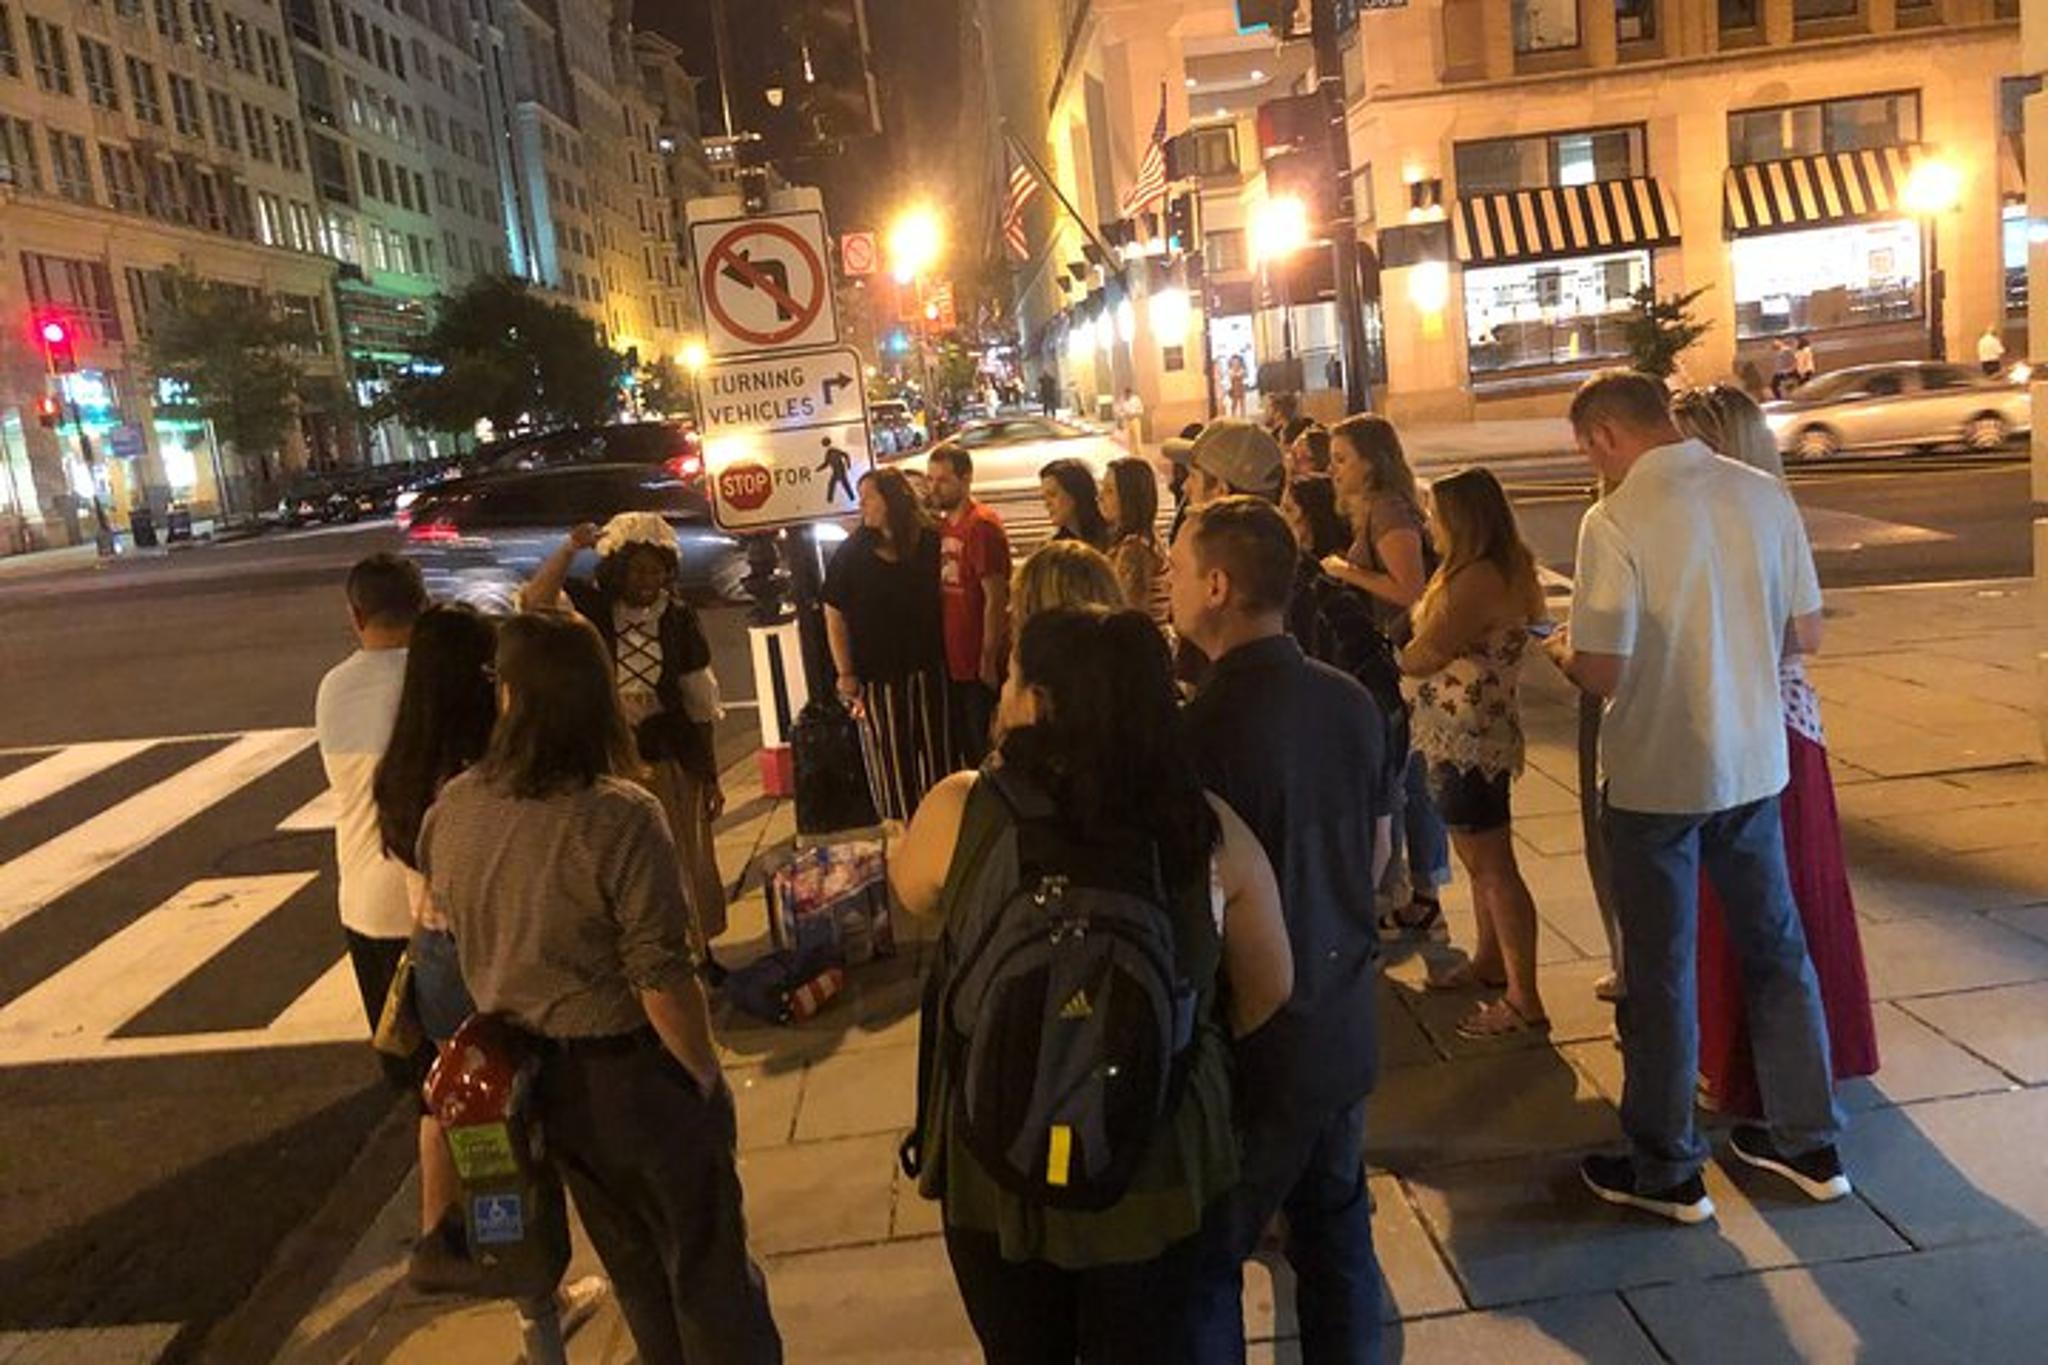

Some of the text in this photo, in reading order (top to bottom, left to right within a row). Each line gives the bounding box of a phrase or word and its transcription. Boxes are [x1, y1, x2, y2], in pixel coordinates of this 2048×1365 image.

[710, 366, 805, 395] TURNING
[707, 397, 814, 425] VEHICLES
[724, 466, 812, 497] STOP FOR
